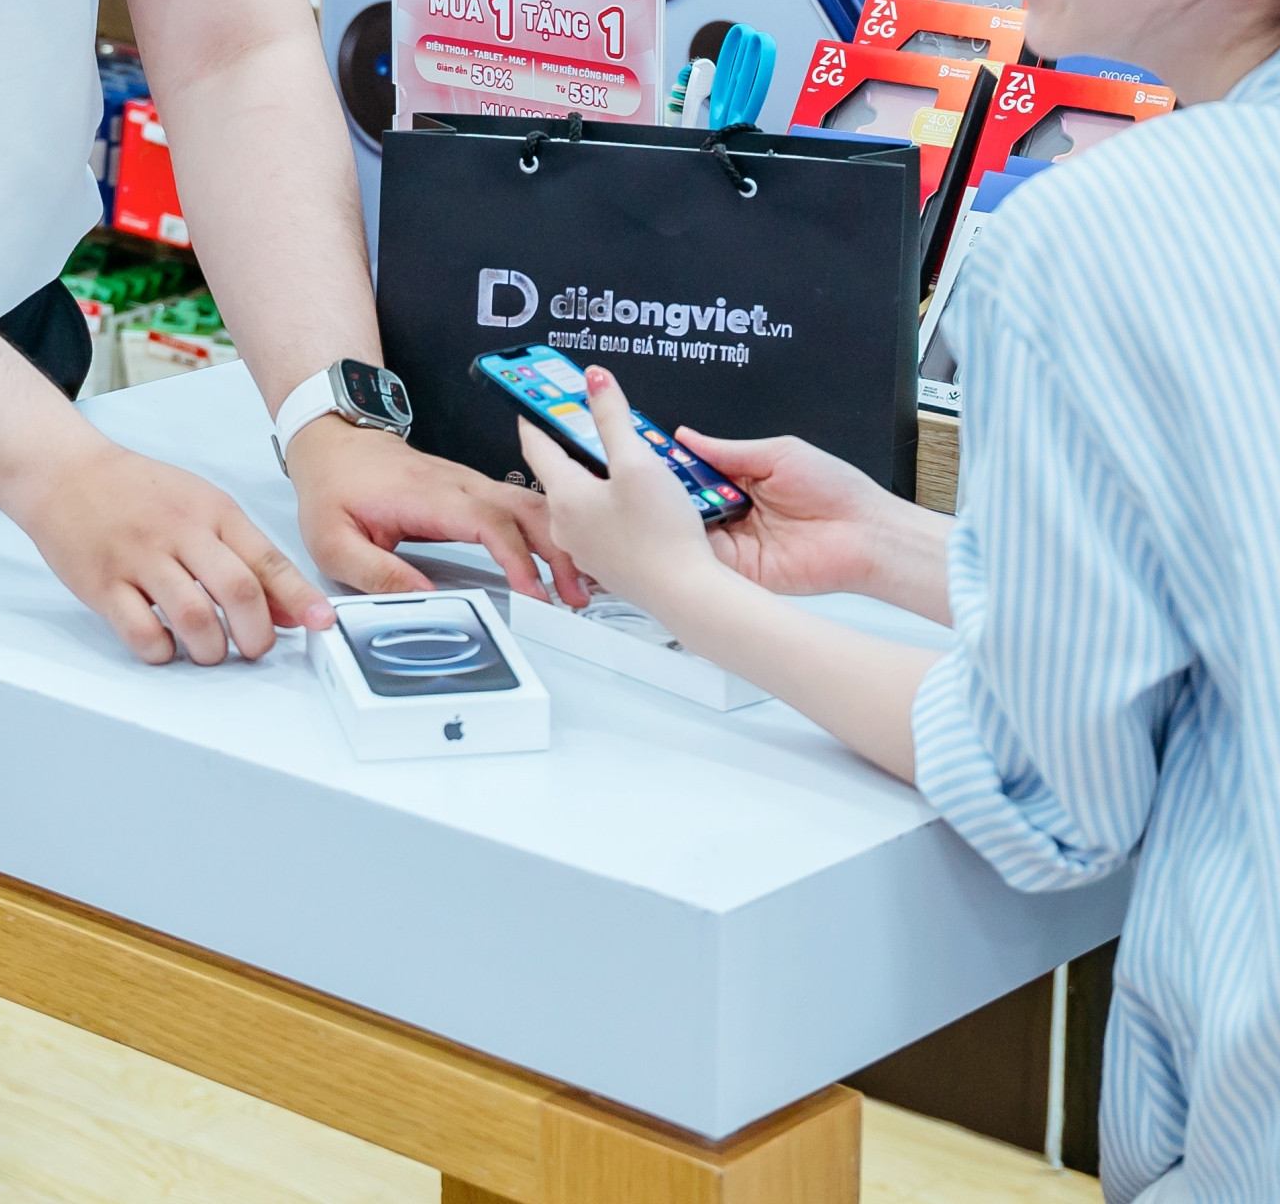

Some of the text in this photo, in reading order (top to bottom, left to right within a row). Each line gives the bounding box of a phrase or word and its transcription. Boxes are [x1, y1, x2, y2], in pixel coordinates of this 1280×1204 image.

[521, 0, 590, 42] TẶNG
[597, 5, 626, 61] 1
[425, 41, 527, 66] ĐIỆN THOẠI TABLET MAC
[471, 64, 514, 90] 50%
[541, 62, 625, 86] PHỤ KIỆN CÔNG NGHỆ
[568, 82, 608, 108] 59K
[928, 114, 956, 127] 400
[550, 286, 794, 339] didongviet.vn
[548, 327, 750, 367] CHUYỂN GIAO GIÁ TRỊ VƯỢT TRỘI
